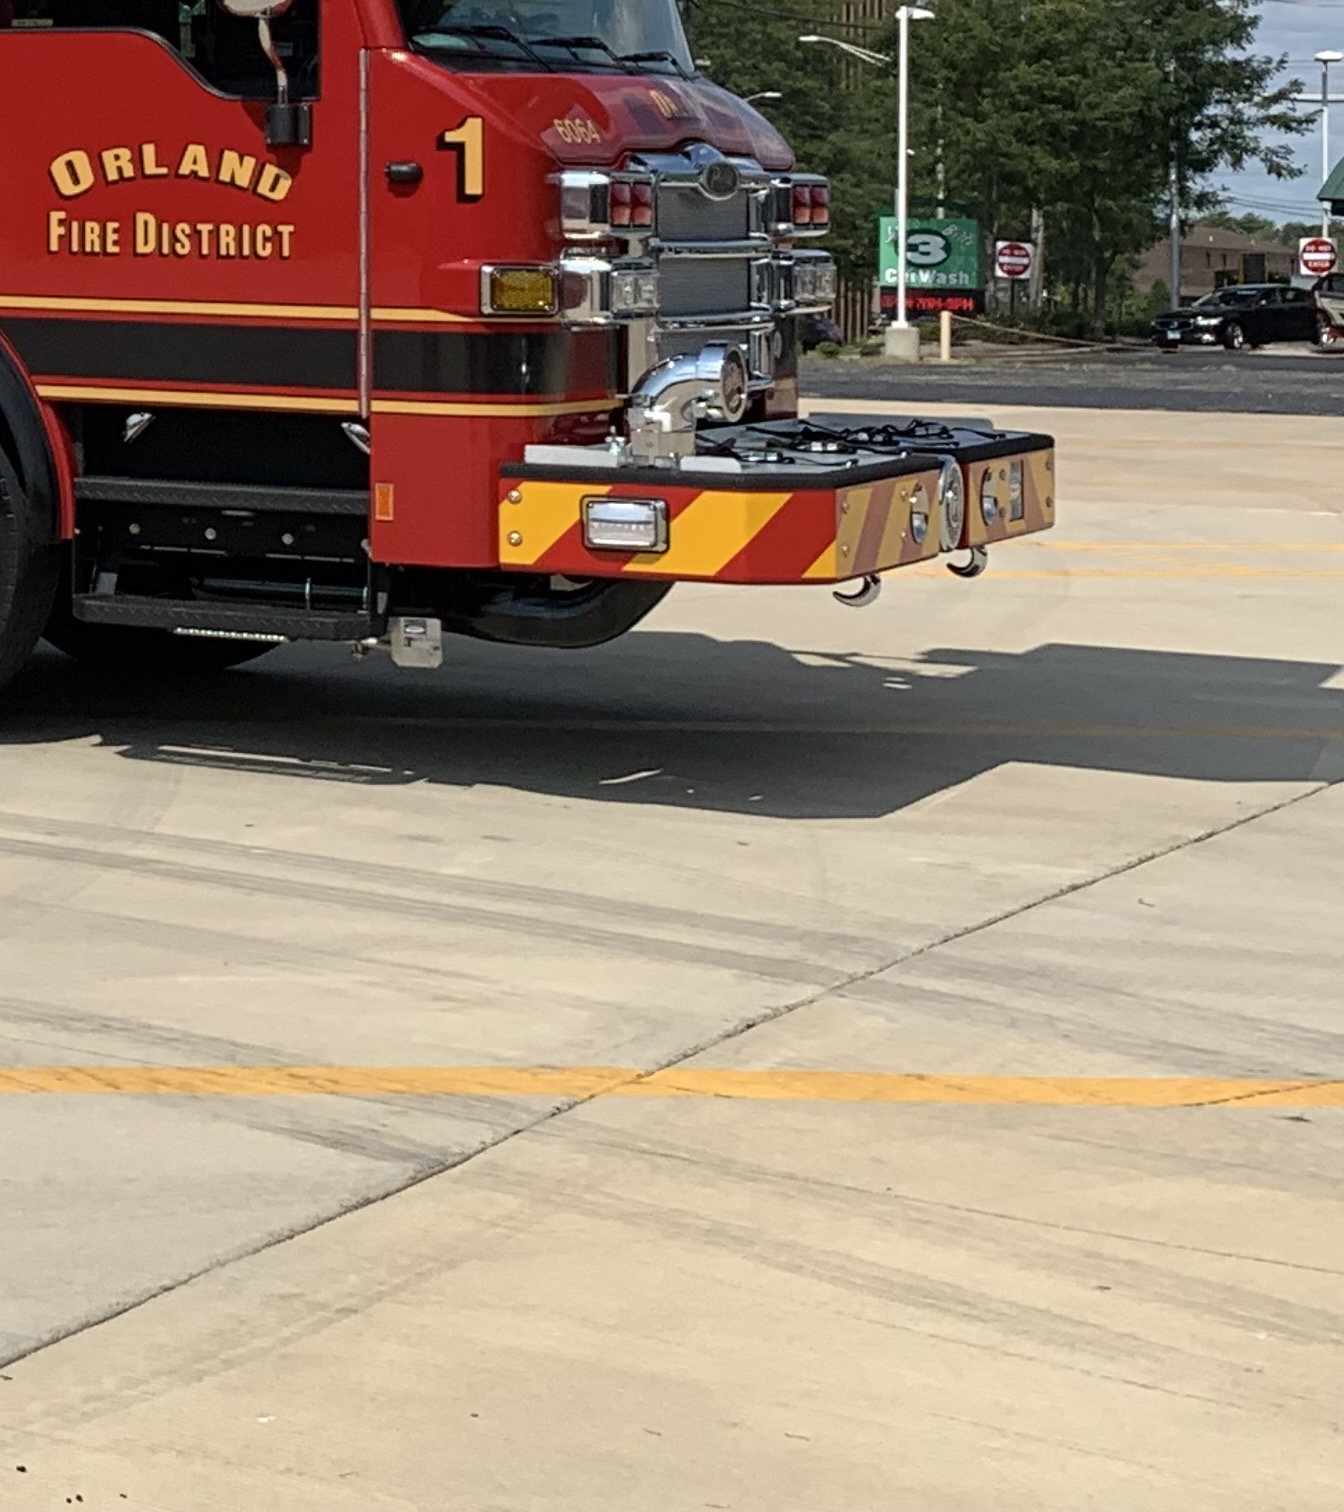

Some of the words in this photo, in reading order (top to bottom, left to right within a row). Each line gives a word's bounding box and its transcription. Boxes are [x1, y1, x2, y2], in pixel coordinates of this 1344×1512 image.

[553, 118, 601, 144] 6064
[49, 143, 294, 202] ORLAND
[439, 116, 483, 198] 1
[48, 210, 120, 254] FIRE
[134, 212, 295, 258] DISTRICT
[906, 233, 948, 265] 3
[917, 269, 970, 285] Wash
